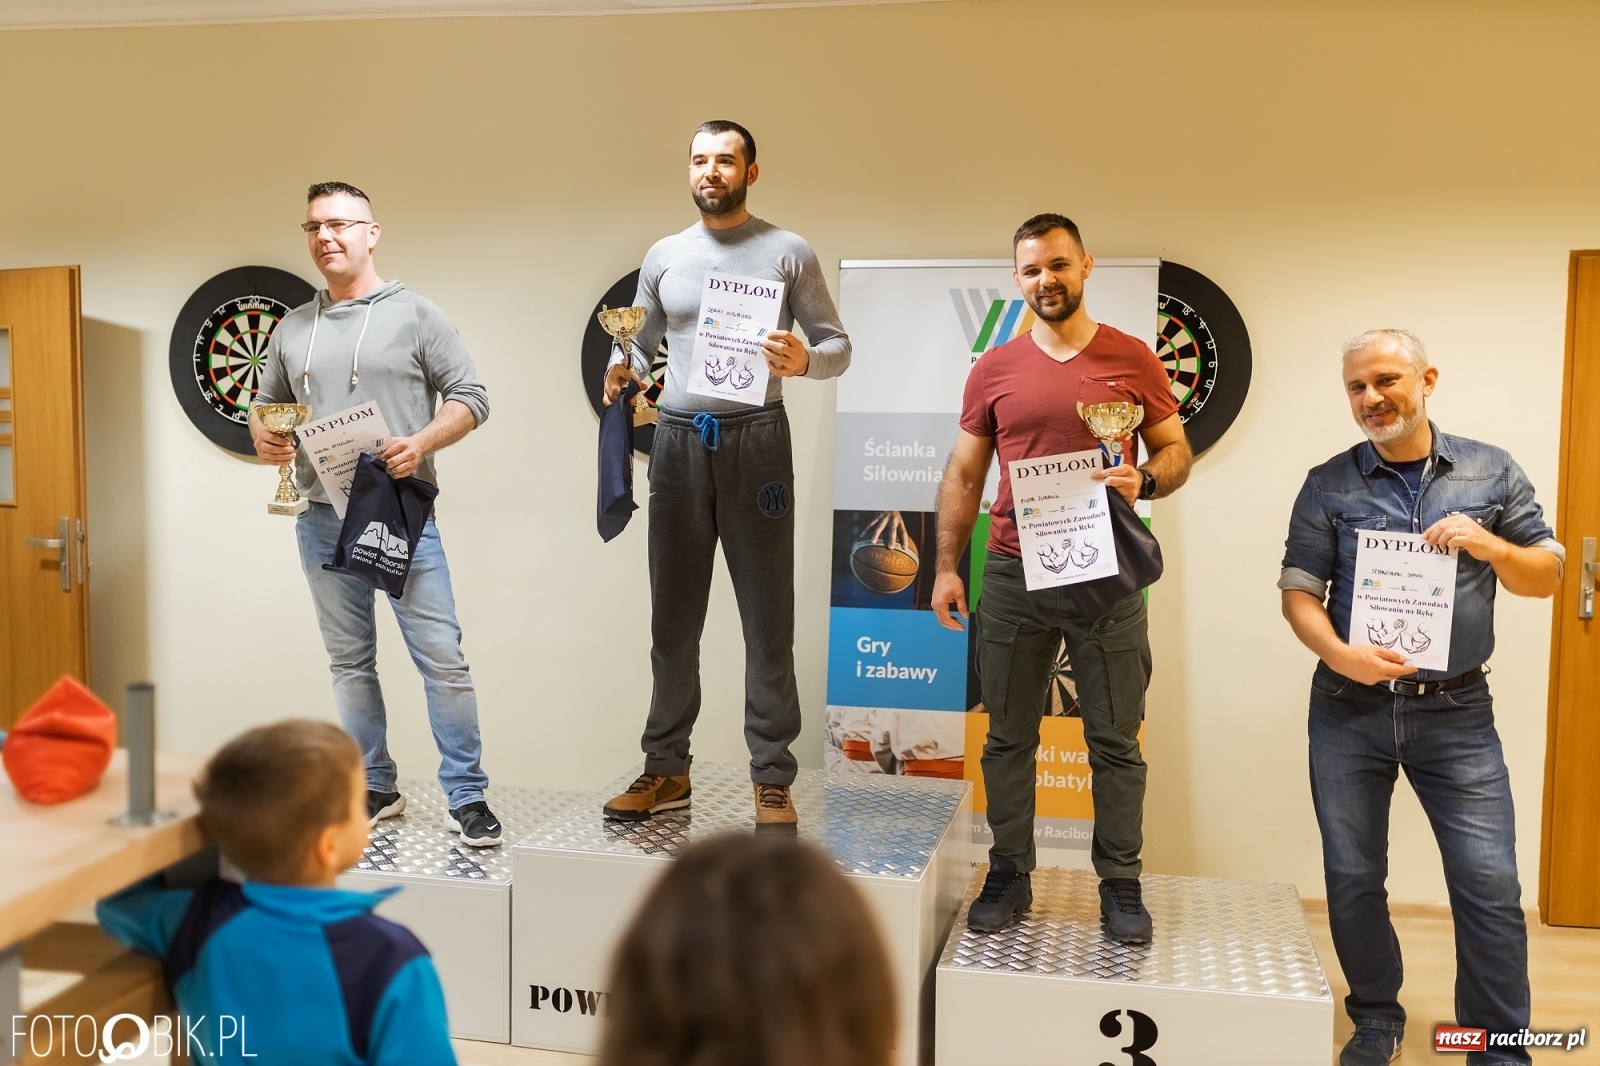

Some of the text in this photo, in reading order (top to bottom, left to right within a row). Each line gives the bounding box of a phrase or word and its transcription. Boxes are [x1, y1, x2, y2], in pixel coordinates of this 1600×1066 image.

[708, 278, 778, 300] DYPLOM
[705, 331, 741, 344] Powiatowych
[741, 338, 765, 348] Zawoda
[303, 407, 376, 438] DYPLOM
[864, 437, 936, 458] Ścianka
[863, 465, 943, 483] Siłownia
[1016, 457, 1097, 479] DYPLOM
[1028, 517, 1072, 529] Powiatowych
[1073, 511, 1106, 523] Zawodach
[1035, 527, 1068, 538] Siłowaniu
[1079, 523, 1096, 532] Rękę
[352, 546, 378, 560] powiat
[1365, 538, 1451, 556] DYPLOM
[1365, 594, 1410, 605] Powiatowych
[1412, 599, 1449, 609] Zawodach
[1369, 604, 1403, 614] Siłowaniu
[1416, 608, 1434, 618] Rękę
[856, 635, 892, 657] Gry
[856, 660, 938, 684] i zabawy
[1059, 750, 1088, 764] wa
[1097, 1009, 1159, 1066] 3
